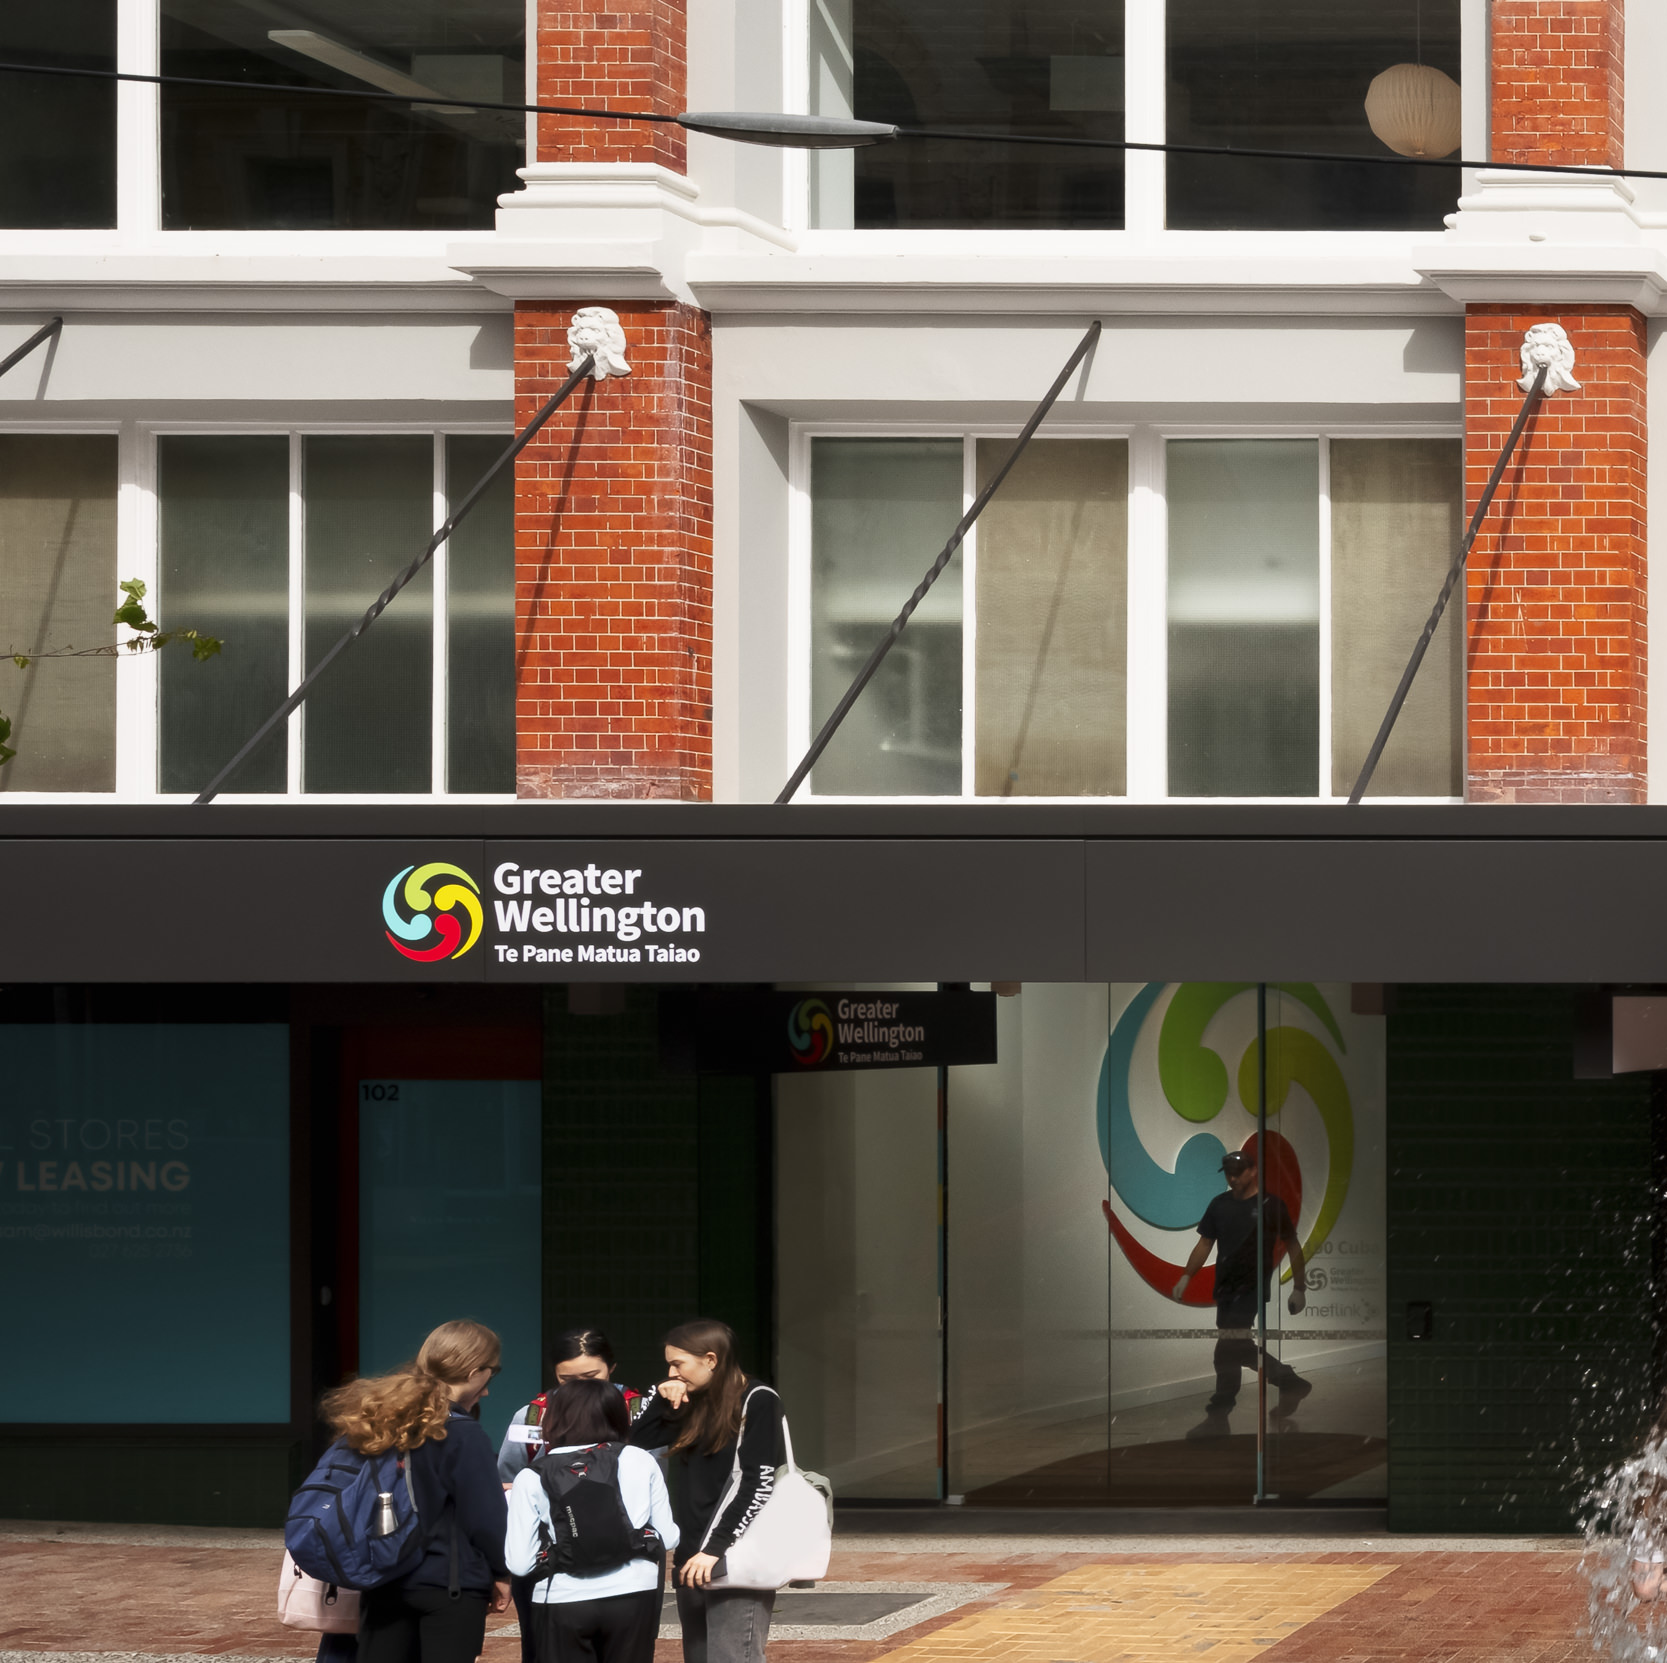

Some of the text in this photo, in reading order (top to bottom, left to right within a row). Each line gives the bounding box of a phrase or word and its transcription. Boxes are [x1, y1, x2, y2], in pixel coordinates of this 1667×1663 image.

[494, 862, 642, 895] Greater
[494, 897, 705, 941] Wellington
[494, 943, 700, 962] Te Pane Matua Taiao
[837, 999, 899, 1019] Greater
[837, 1023, 925, 1047] Wellington
[838, 1050, 922, 1064] Te Pane Matua Taiao
[362, 1085, 399, 1101] 102
[30, 1120, 190, 1151] STORES
[17, 1160, 192, 1192] LEASING
[1305, 1303, 1361, 1317] metlink
[565, 1505, 579, 1538] macpac
